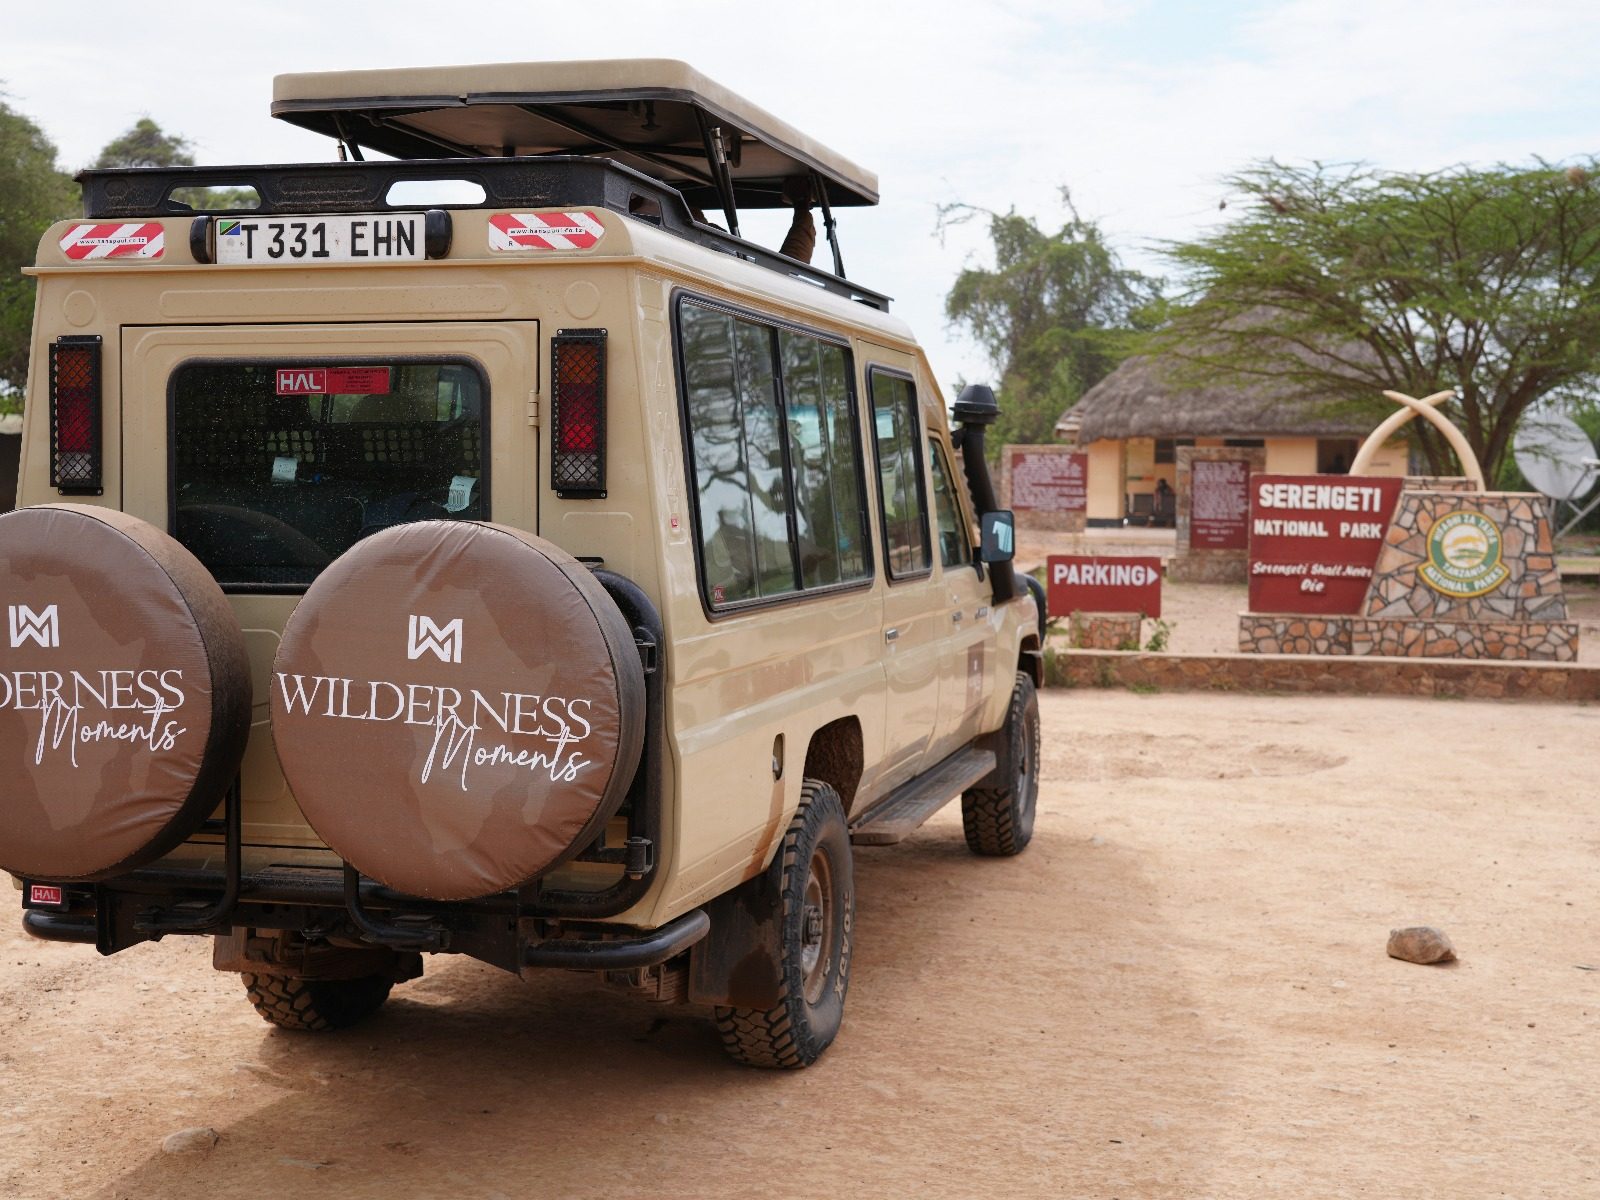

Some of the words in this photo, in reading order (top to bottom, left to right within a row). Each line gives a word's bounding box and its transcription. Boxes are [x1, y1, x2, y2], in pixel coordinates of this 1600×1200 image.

[241, 224, 258, 259] T
[267, 222, 330, 259] 331
[351, 219, 415, 257] EHN
[280, 373, 322, 391] HAL
[1259, 483, 1382, 513] SERENGETI
[1253, 518, 1329, 538] NATIONAL
[1340, 521, 1383, 539] PARK
[1053, 563, 1146, 587] PARKING
[1252, 561, 1309, 577] Serengeti
[1310, 563, 1342, 576] Shall
[1300, 578, 1325, 593] Die
[276, 672, 593, 741] WILDERNESS
[35, 696, 187, 768] Moments
[421, 713, 592, 792] Moments
[34, 889, 57, 900] HAL
